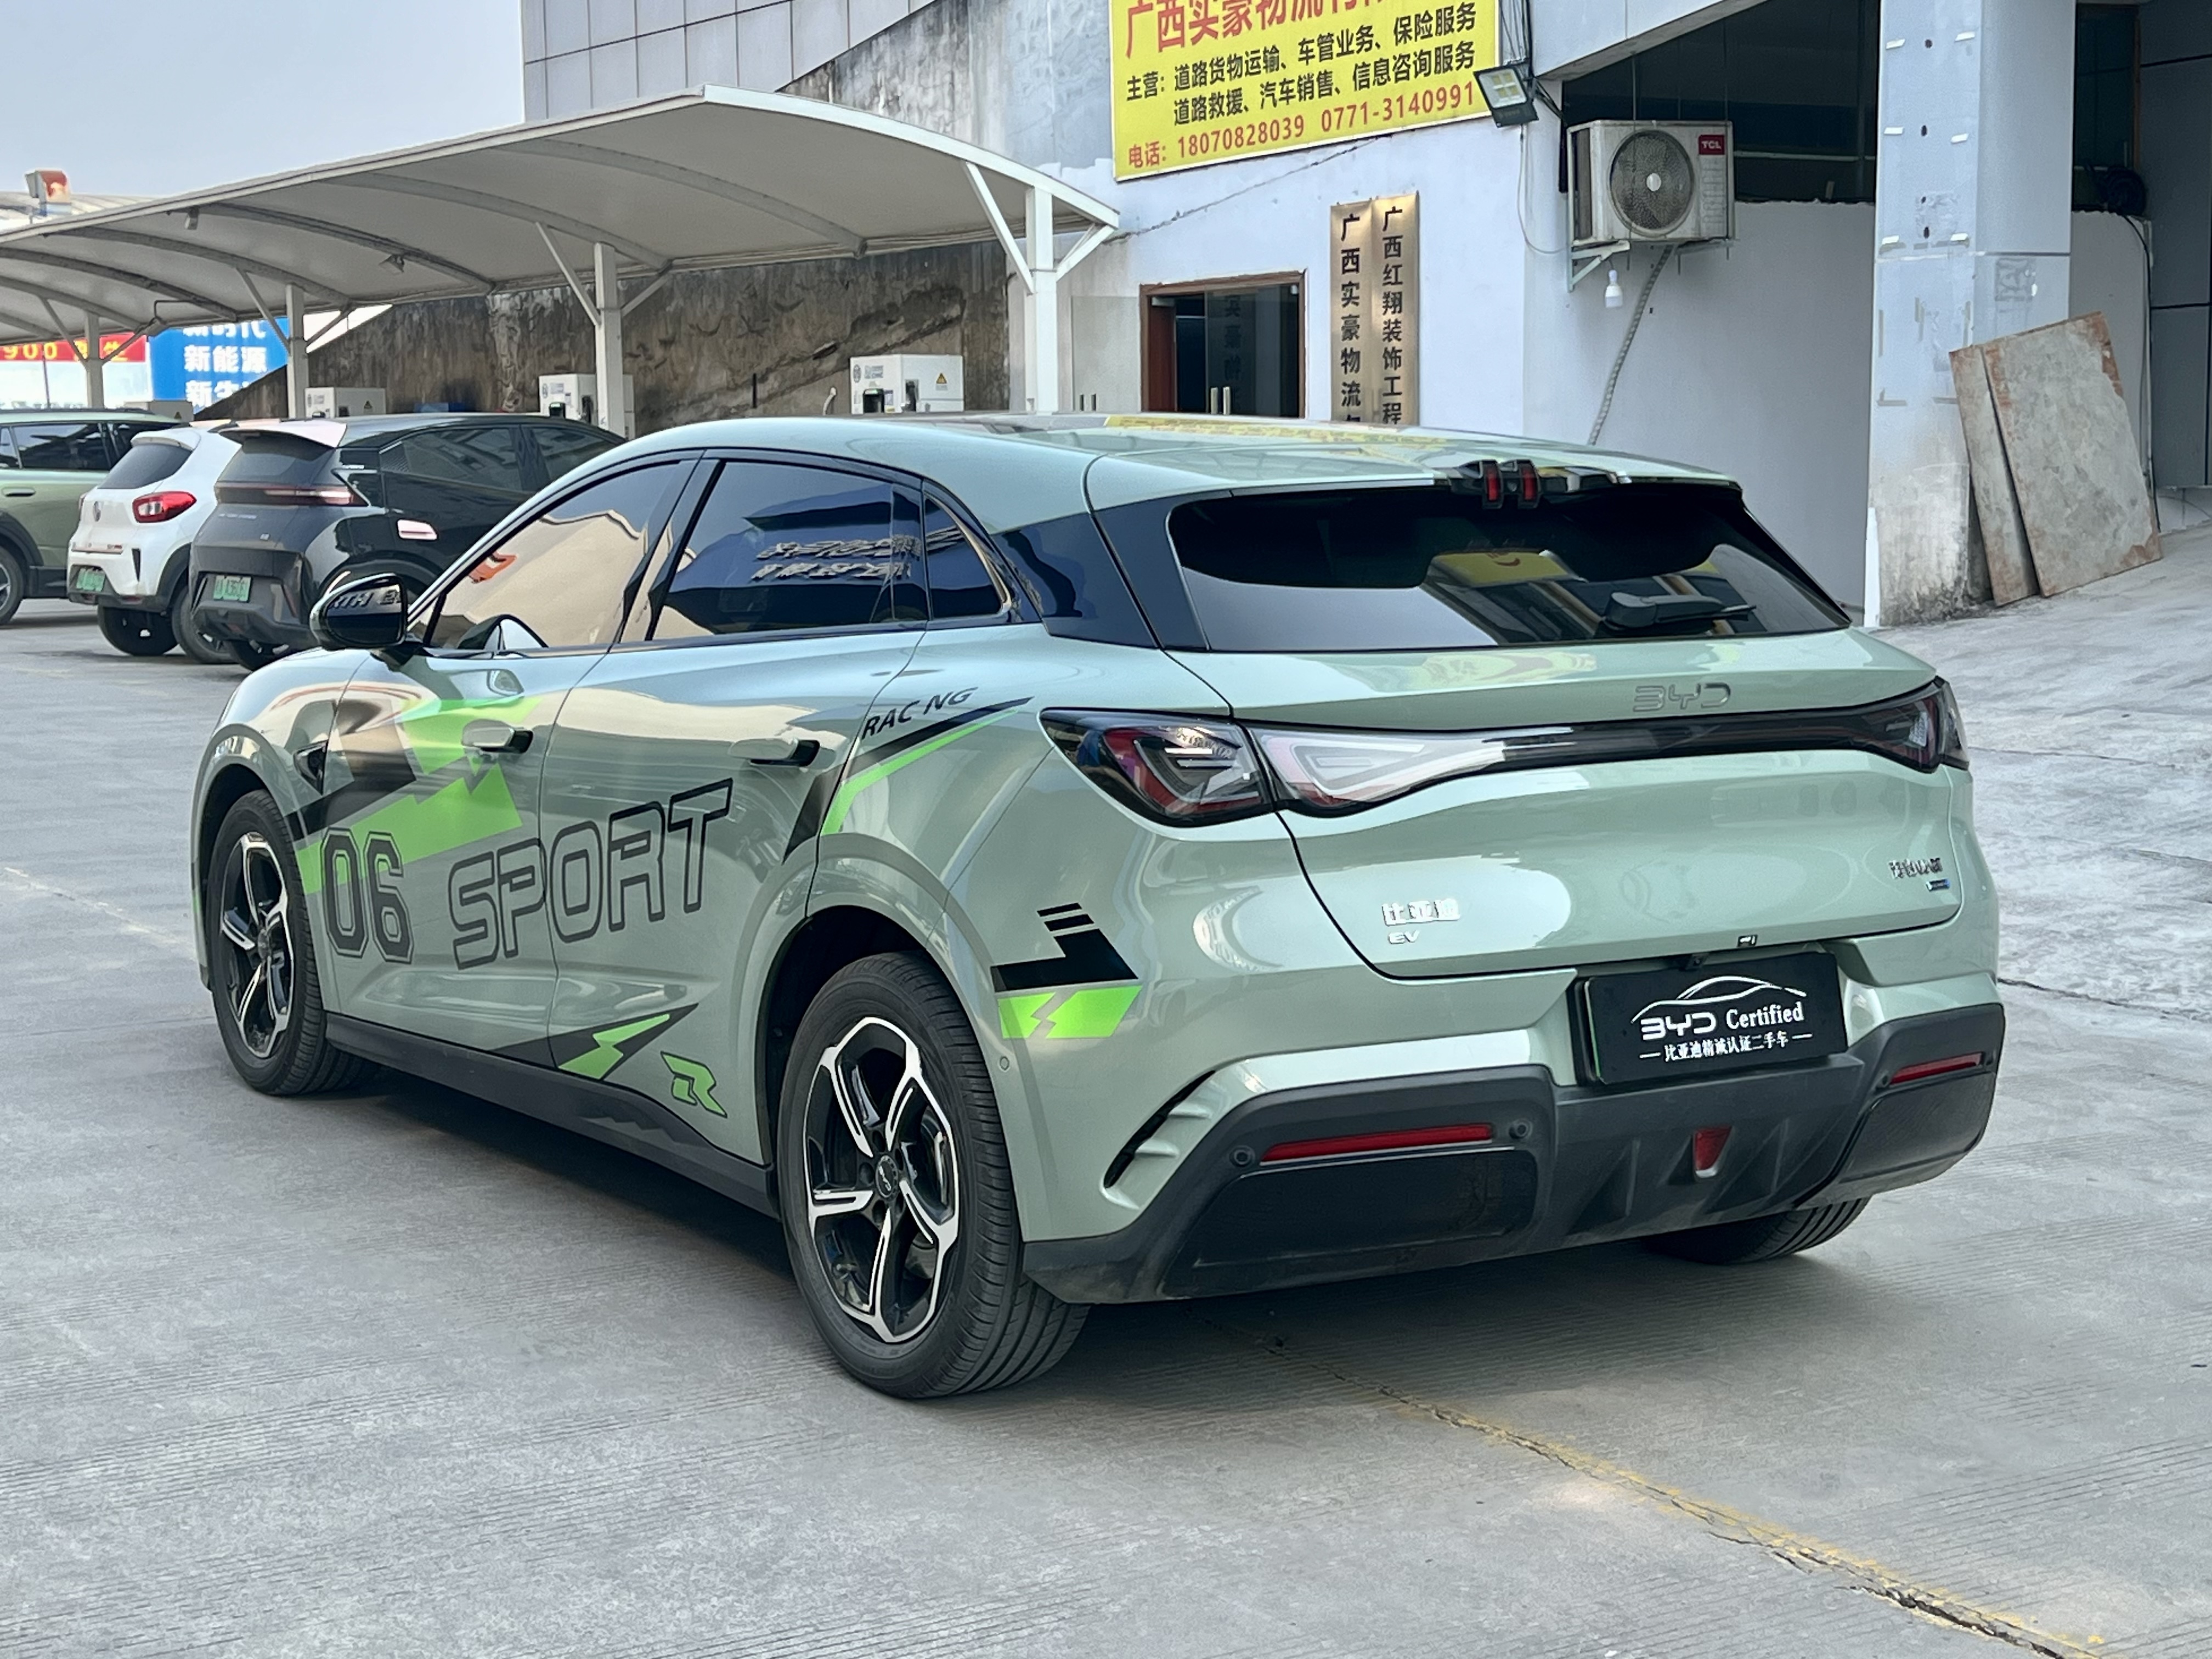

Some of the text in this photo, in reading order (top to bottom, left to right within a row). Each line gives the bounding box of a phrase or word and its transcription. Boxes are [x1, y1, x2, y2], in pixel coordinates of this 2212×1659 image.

[1321, 81, 1473, 132] 0771-3140991
[1701, 140, 1722, 149] TCL
[1382, 206, 1403, 425] 广西红翔装饰工程
[184, 345, 268, 373] 新能源
[185, 380, 251, 407] 新生
[861, 687, 979, 740] RACNG
[1633, 682, 1731, 712] BYD
[320, 777, 734, 970] 06 SPORT
[1387, 930, 1420, 945] EV
[1640, 1001, 1805, 1041] BYD Certified
